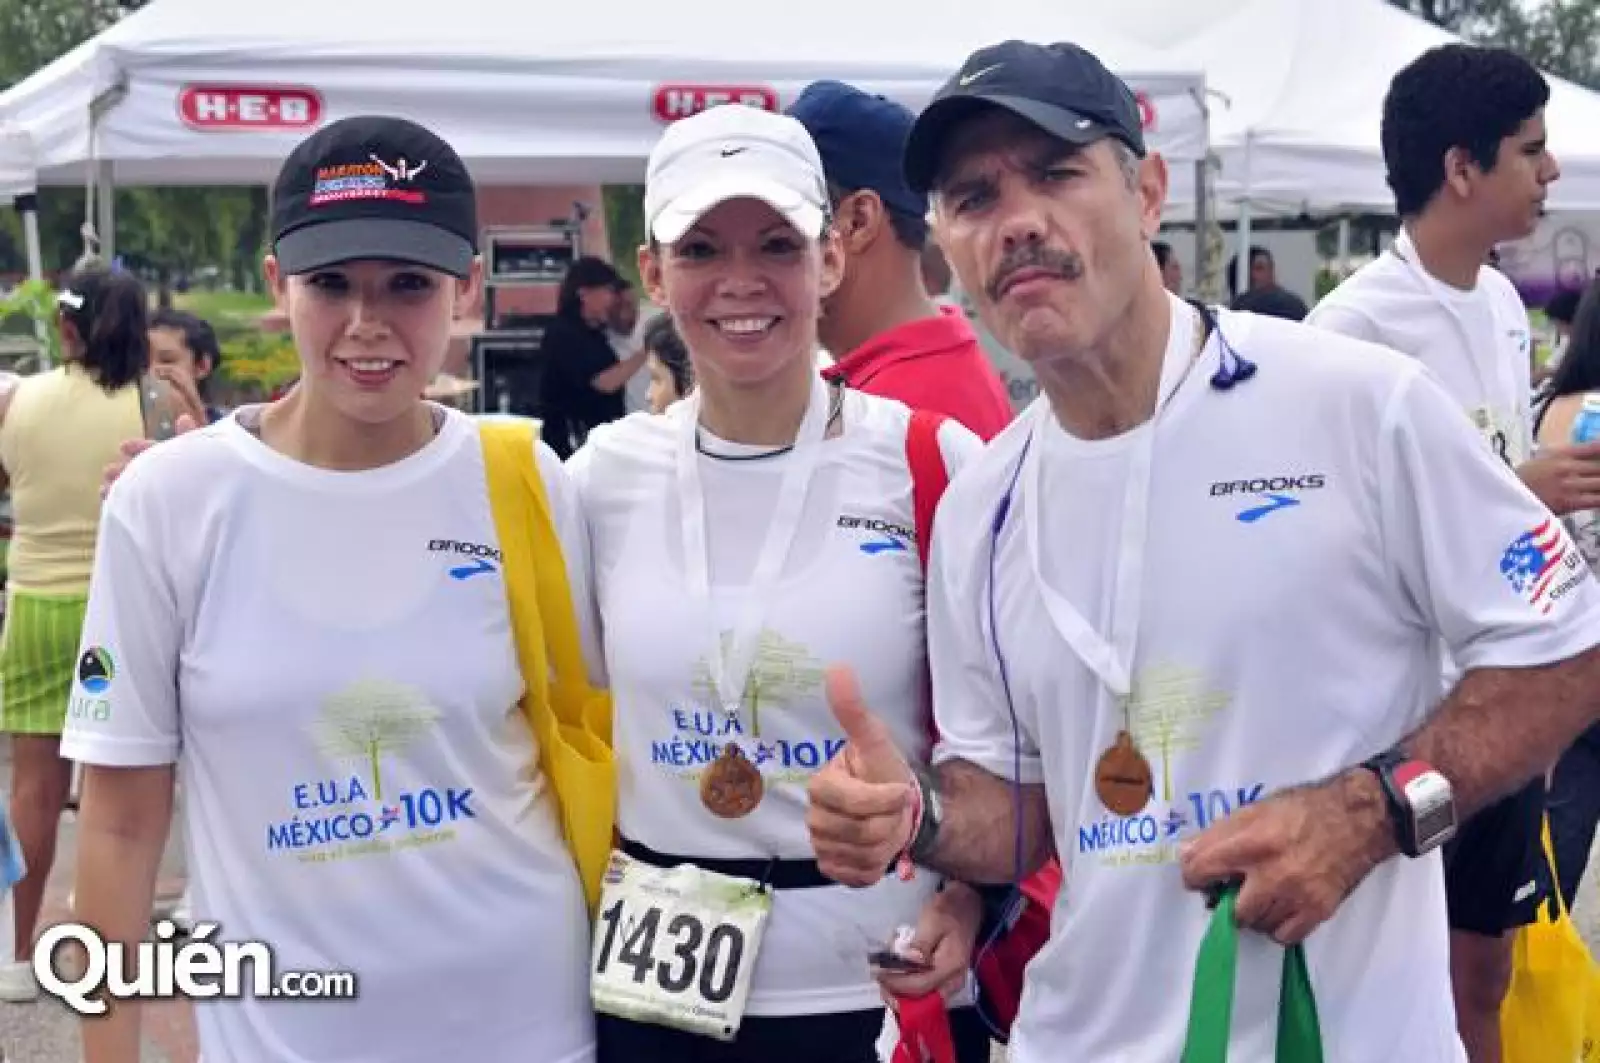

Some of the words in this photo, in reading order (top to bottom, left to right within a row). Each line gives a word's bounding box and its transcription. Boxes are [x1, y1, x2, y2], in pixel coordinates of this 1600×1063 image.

[1209, 474, 1325, 496] BROOKS
[837, 515, 915, 540] BROOK
[294, 775, 369, 809] E.U.A
[266, 812, 373, 849] MÉXICO
[399, 787, 475, 829] 10K
[597, 899, 744, 1003] 1430
